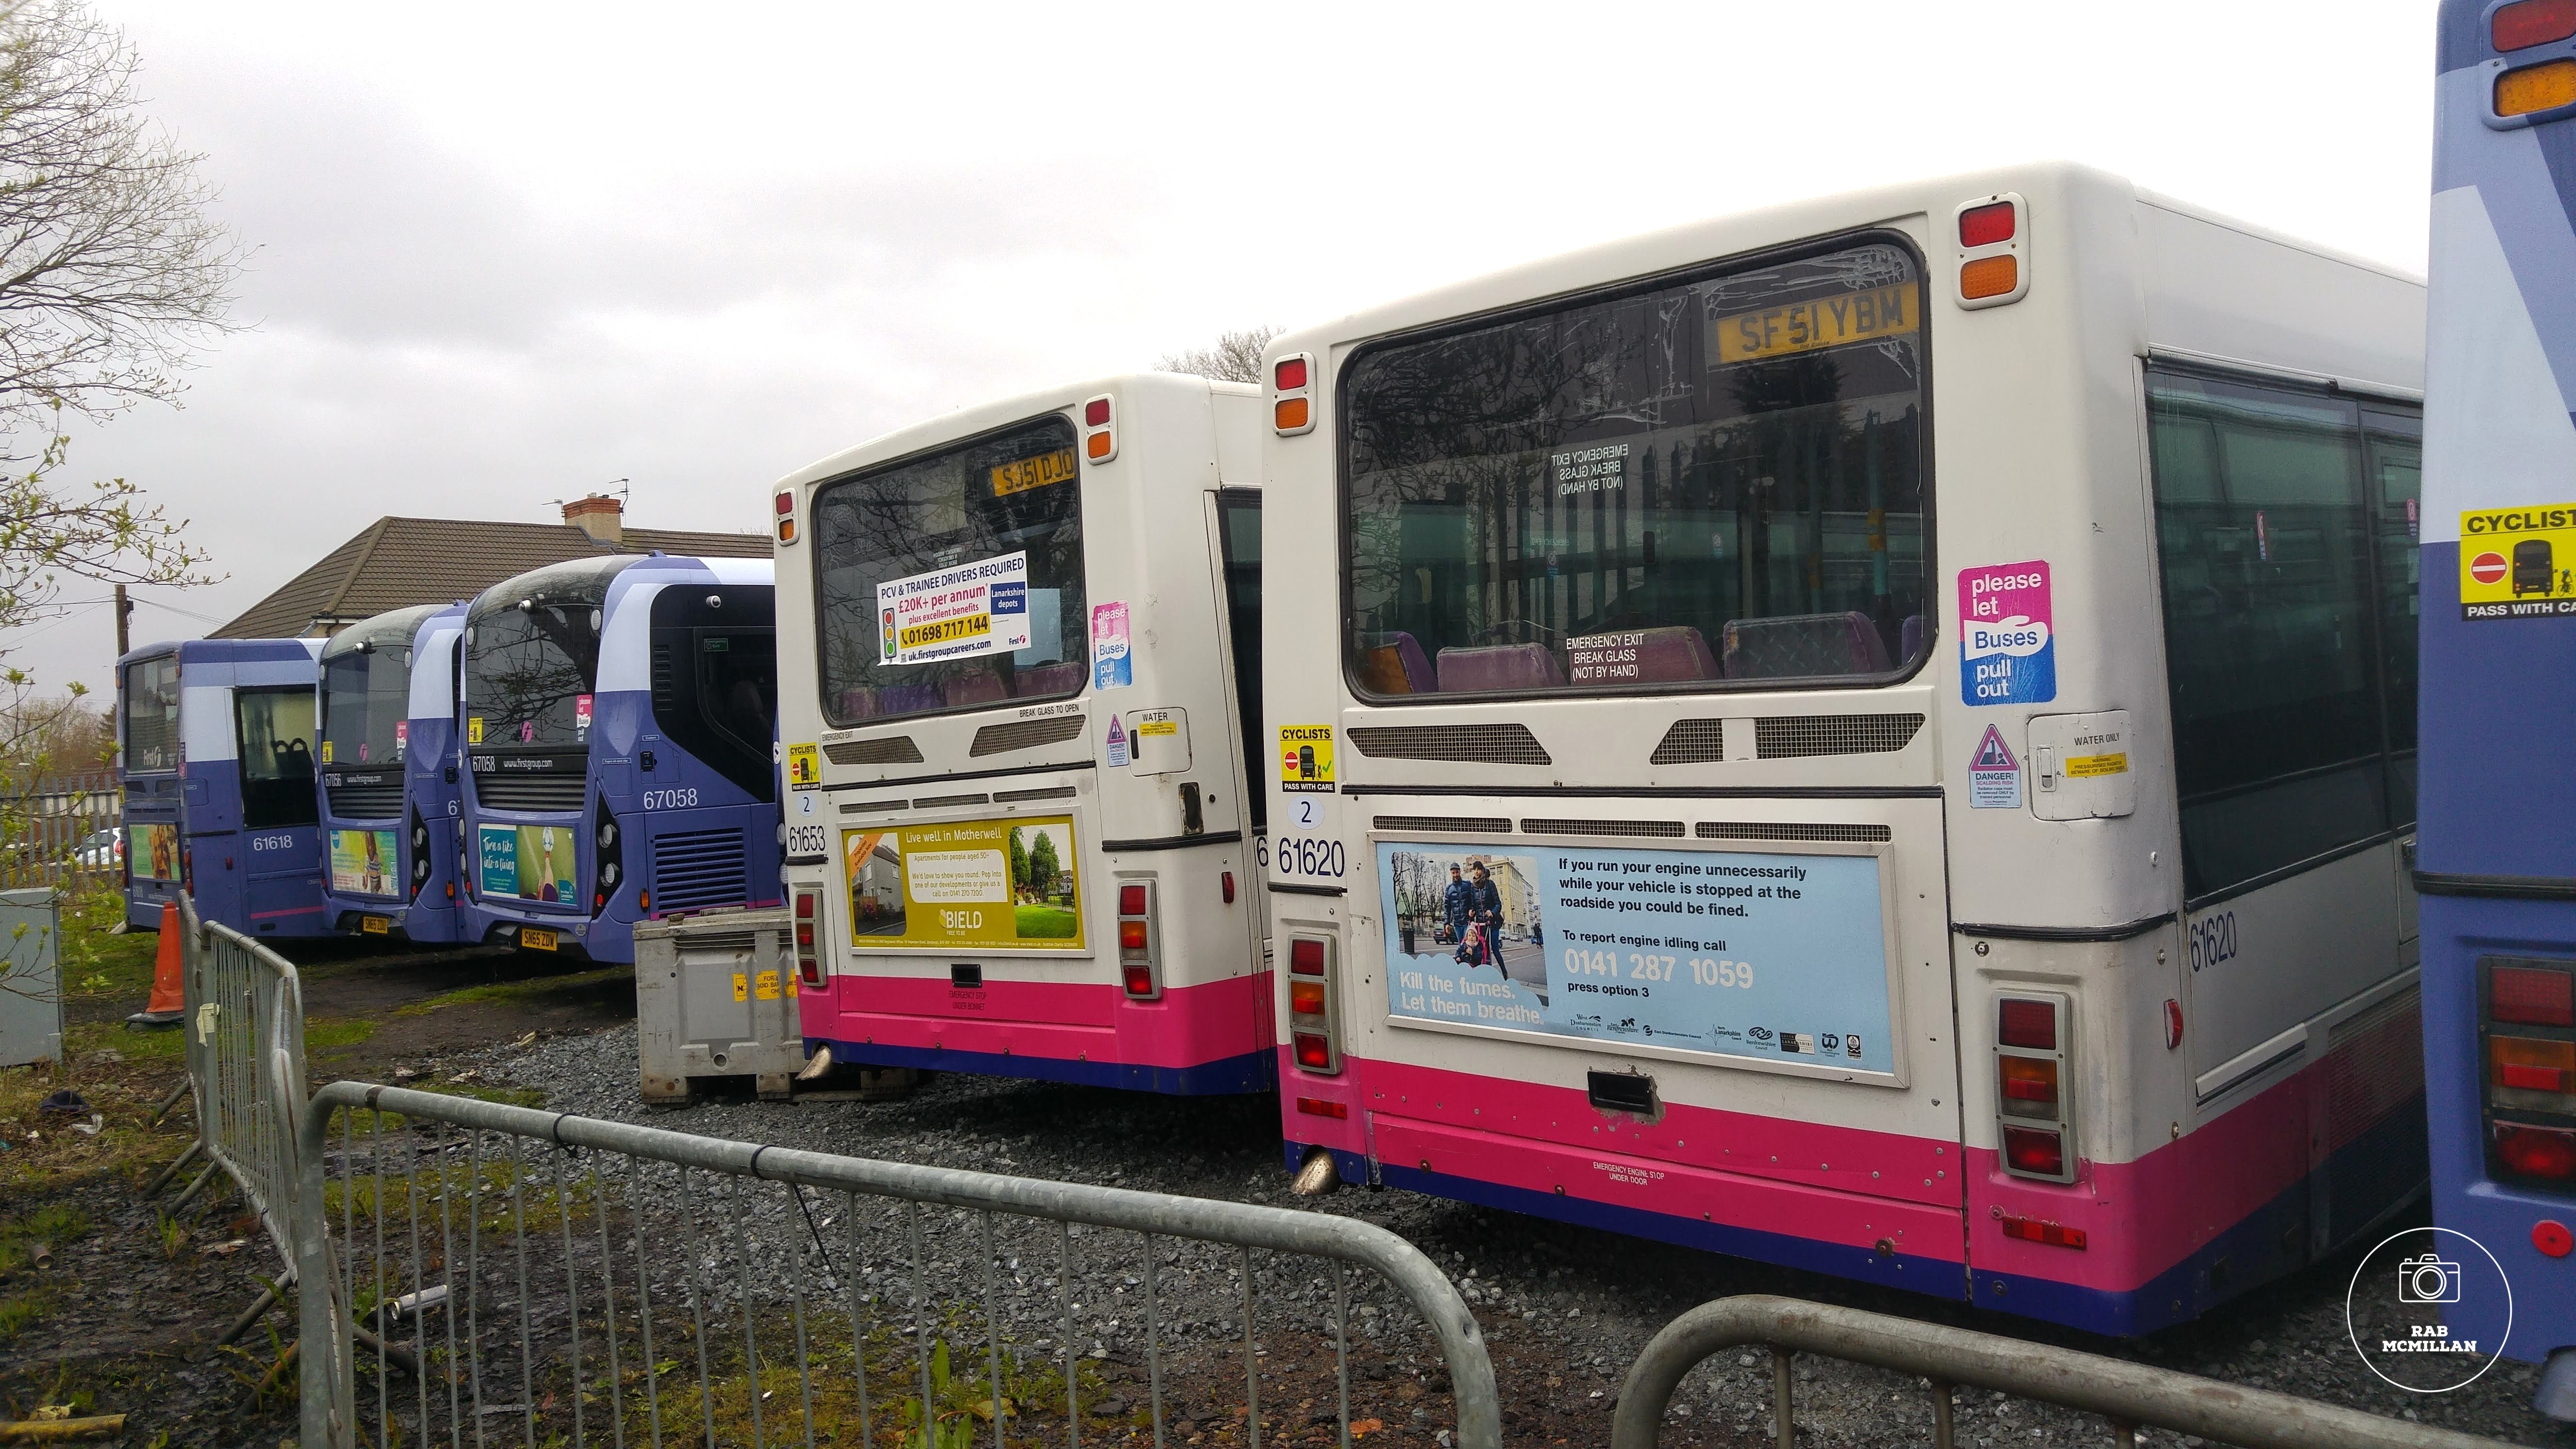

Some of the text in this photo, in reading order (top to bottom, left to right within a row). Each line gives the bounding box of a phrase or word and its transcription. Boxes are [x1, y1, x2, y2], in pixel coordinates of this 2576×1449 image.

[1740, 289, 1904, 353] SF51 YBM
[1003, 460, 1039, 490] SJ51
[882, 558, 1024, 599] PCV & TRAINEE DRIVERS REQUIRED
[1972, 573, 2042, 598] please
[991, 587, 1025, 597] Lanarkshire
[899, 597, 929, 613] £20K+
[932, 594, 949, 610] per
[998, 600, 1018, 610] depots
[1973, 596, 1998, 616] let
[2468, 605, 2508, 616] PASS
[2512, 603, 2553, 613] WITH
[909, 603, 979, 626] plus excellent benefits
[1097, 608, 1126, 621] please
[909, 616, 988, 644] 01698 717 144
[1098, 625, 1109, 636] let
[1009, 637, 1019, 645] First
[1566, 633, 1644, 650] EMERGENCY EXIT
[1975, 631, 2038, 649] Buses
[908, 640, 991, 661] uk.firstgroupcareers.com
[1100, 643, 1125, 655] Buses
[1574, 649, 1636, 664] BREAK GLASS
[1101, 661, 1114, 676] pull
[1573, 664, 1638, 681] (NOT BY HAND)
[1977, 660, 2011, 682] pull
[1101, 675, 1114, 686] out
[1977, 679, 2010, 698] out
[1020, 704, 1079, 717] BREAK GLASS TO OPEN
[1142, 712, 1168, 722] WATER
[822, 732, 845, 741] EMERGENCY
[1282, 729, 1330, 739] CYCLISTS
[2074, 732, 2120, 745] WATER ONLY
[790, 745, 817, 754] CYCLISTS
[473, 756, 552, 772] 67058 www.firstgroup.com
[325, 773, 341, 786] 67056
[644, 788, 698, 810] 67058
[804, 797, 810, 812] 2
[1301, 801, 1312, 823] 2
[253, 835, 292, 851] 61618
[789, 825, 825, 852] 61653
[906, 827, 1002, 843] Live well in Motherwell
[483, 836, 497, 852] Turn
[502, 839, 514, 853] like
[914, 854, 940, 862] Apartments
[950, 853, 966, 862] people
[967, 853, 979, 861] aged
[1279, 837, 1345, 877] 61620
[500, 858, 514, 875] living
[1559, 858, 1806, 882] If you run your engine unnecessarily
[939, 881, 972, 889] developments
[979, 881, 989, 889] give
[1560, 877, 1801, 899] while your vehicle is stopped at the
[1561, 897, 1749, 917] roadside you could be fined.
[946, 911, 982, 929] BIELD
[525, 931, 555, 948] SN65 ZDW
[1563, 930, 1726, 951] To report engine idling call
[2190, 911, 2237, 972] 61620
[1565, 948, 1754, 989] 0141 287 1059
[1401, 972, 1515, 999] Kill the fumes.
[1568, 982, 1649, 997] press option 3
[949, 991, 975, 999] EMERGENCY
[1401, 992, 1545, 1025] Let them breathe.
[1715, 1029, 1741, 1037] Lanarkshire
[1593, 1161, 1626, 1174] EMERGENCY
[1609, 1173, 1647, 1185] UNDER DOOR
